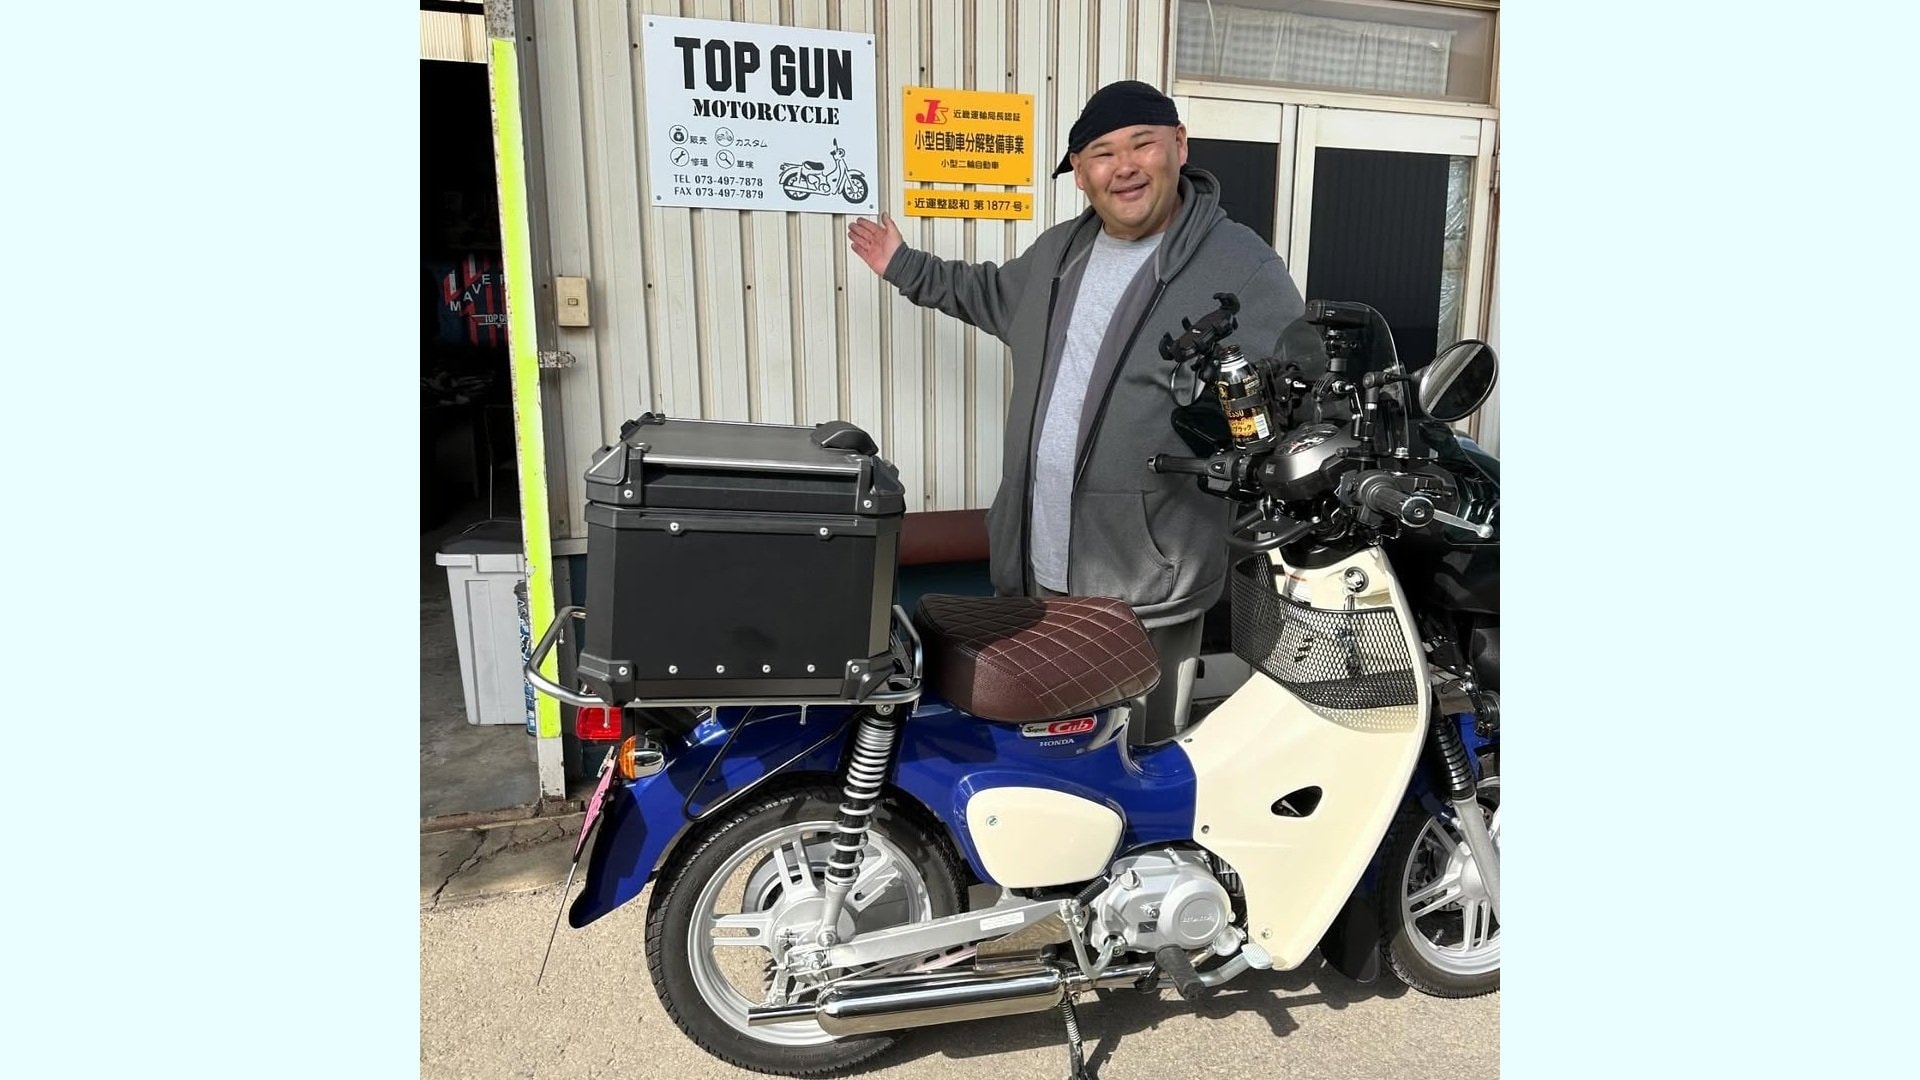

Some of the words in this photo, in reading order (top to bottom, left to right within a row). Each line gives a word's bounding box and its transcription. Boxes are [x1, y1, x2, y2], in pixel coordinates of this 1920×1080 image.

[674, 36, 760, 93] TOP
[770, 44, 853, 100] GUN
[692, 98, 840, 125] MOTORCYCLE
[689, 135, 708, 145] 販売
[735, 138, 768, 148] カスタム
[914, 130, 1025, 154] 小型自動車分解整備事業
[690, 157, 709, 167] 修理
[736, 159, 754, 169] 車検
[941, 158, 999, 170] 小型二輪自動車
[673, 174, 691, 184] TEL
[694, 174, 763, 187] 073-497-7878
[674, 186, 692, 196] FAX
[695, 187, 764, 199] 073-497-7879
[1054, 720, 1089, 733] Cub
[1039, 738, 1075, 747] HONDA
